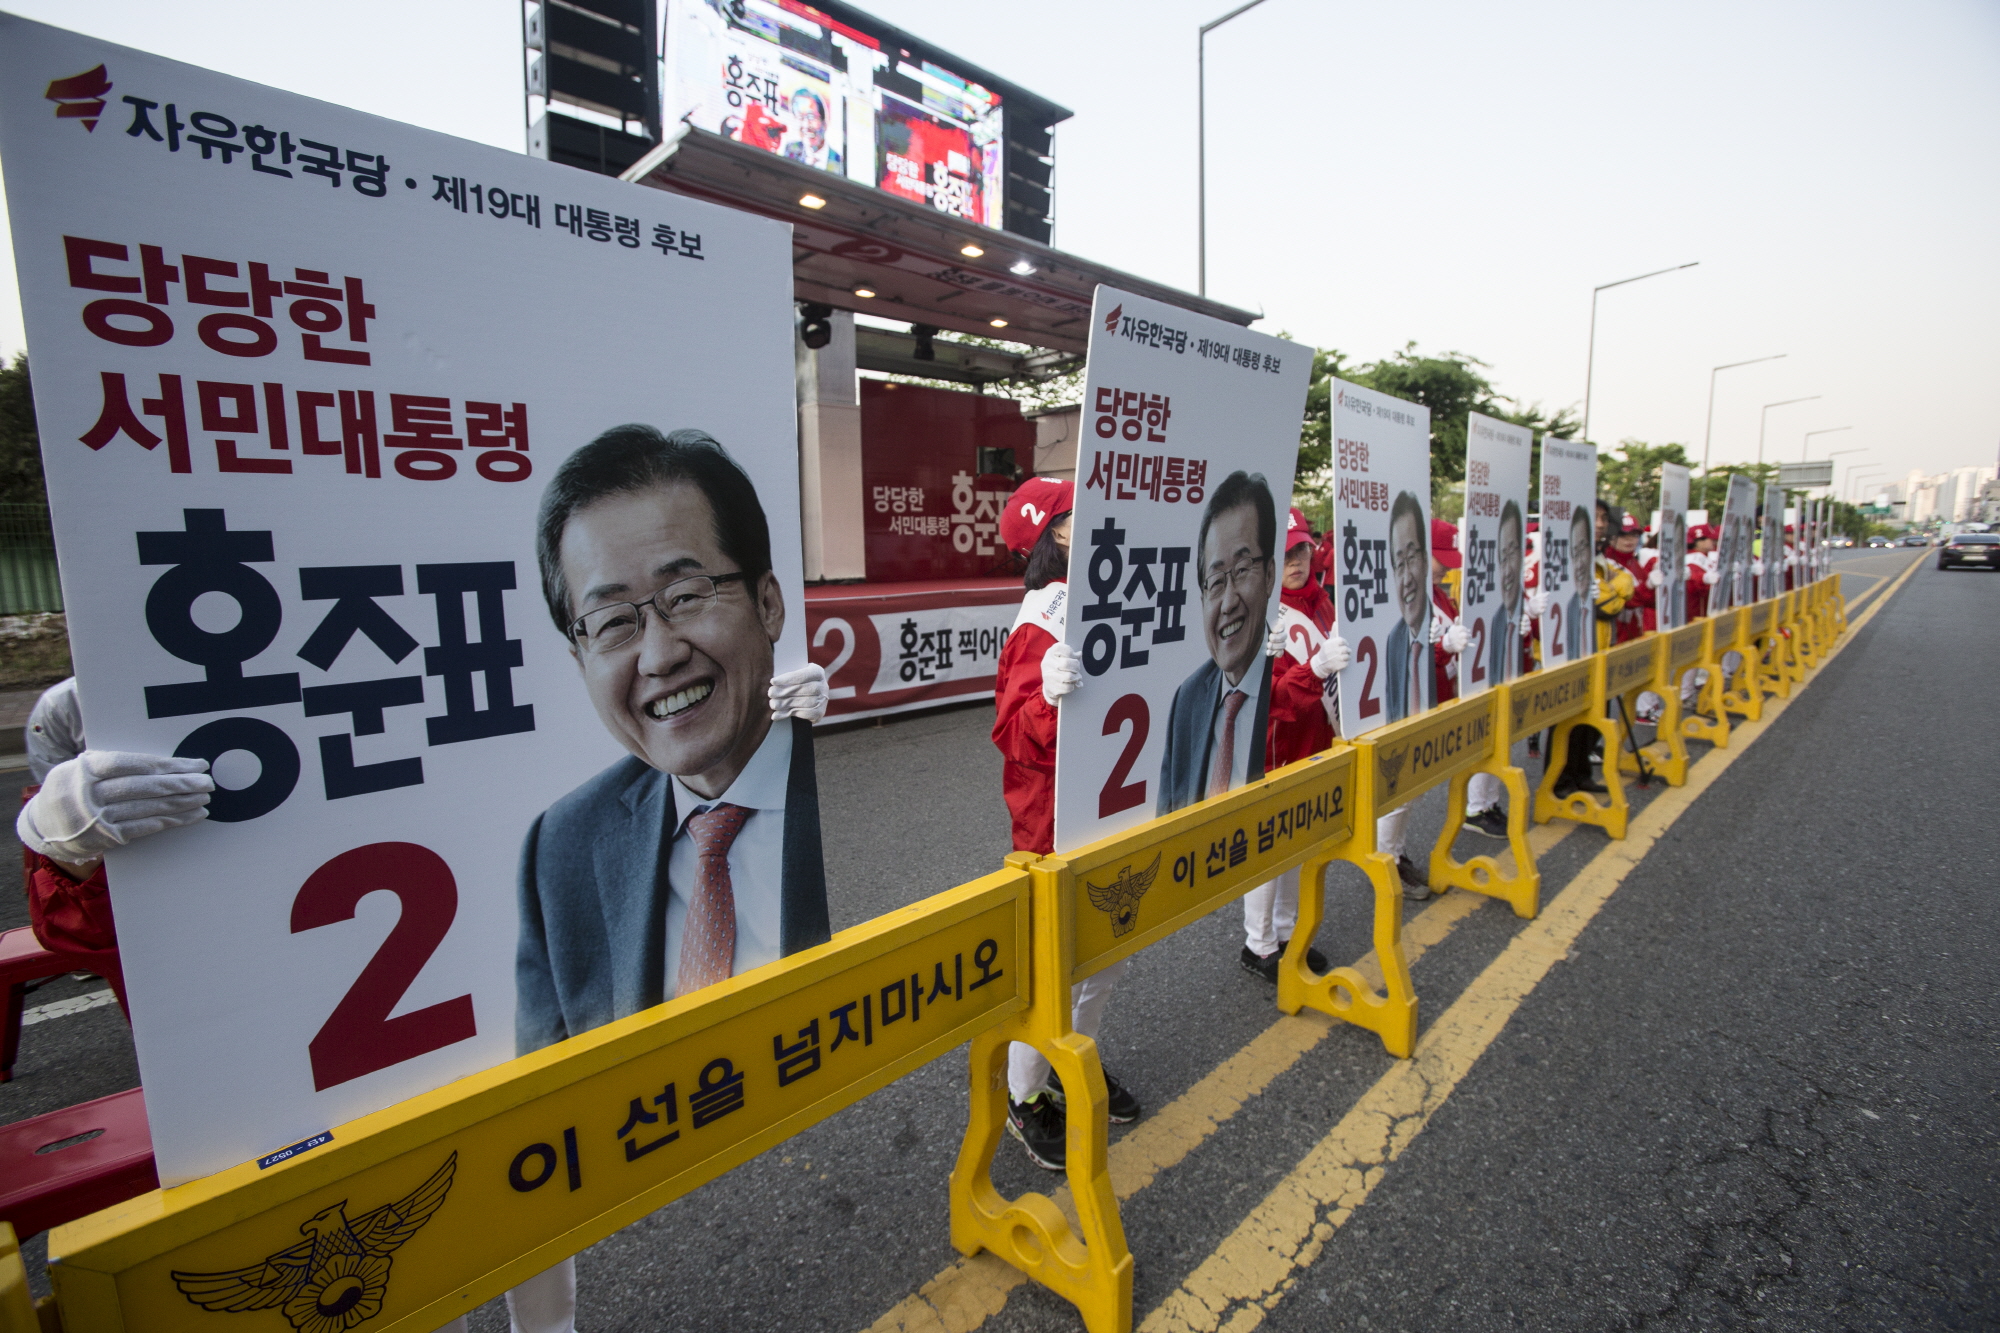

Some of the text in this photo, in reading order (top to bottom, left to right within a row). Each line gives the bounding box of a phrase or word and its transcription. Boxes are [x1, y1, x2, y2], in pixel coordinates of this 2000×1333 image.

[123, 93, 390, 198] 자유한국당
[431, 174, 541, 230] 제19대
[555, 203, 642, 250] 대통령
[650, 224, 705, 261] 후보
[63, 235, 376, 366] 당당한
[1121, 315, 1188, 354] 자유한국당
[1197, 338, 1230, 363] 제19대
[1232, 347, 1261, 371] 대통령
[1262, 354, 1281, 374] 후보
[79, 371, 533, 483] 서민대통령
[1095, 387, 1171, 443] 당당한
[1085, 450, 1207, 504] 서민대통령
[1338, 438, 1369, 473] 당당한
[873, 486, 925, 513] 당당한
[889, 516, 950, 536] 서민대통령
[1020, 502, 1046, 526] 2
[1338, 477, 1389, 512] 서민대통령
[1343, 519, 1389, 622] 홍준표
[1467, 524, 1496, 606] 홍준표
[1544, 526, 1569, 592] 홍준표
[1081, 517, 1191, 676] 홍준표
[1551, 602, 1564, 657] 2
[136, 508, 535, 822] 홍준표
[899, 618, 953, 682] 홍준표
[1289, 623, 1321, 663] 2
[1471, 617, 1485, 684] 2
[1356, 635, 1380, 720] 2
[1534, 686, 1569, 715] POLICE
[1098, 693, 1150, 820] 2
[1412, 714, 1491, 774] POLICE LINE
[1173, 785, 1344, 889] 이 선을 넘지마시오
[290, 841, 477, 1092] 2
[508, 938, 1003, 1193] 이 선을 넘지마시오
